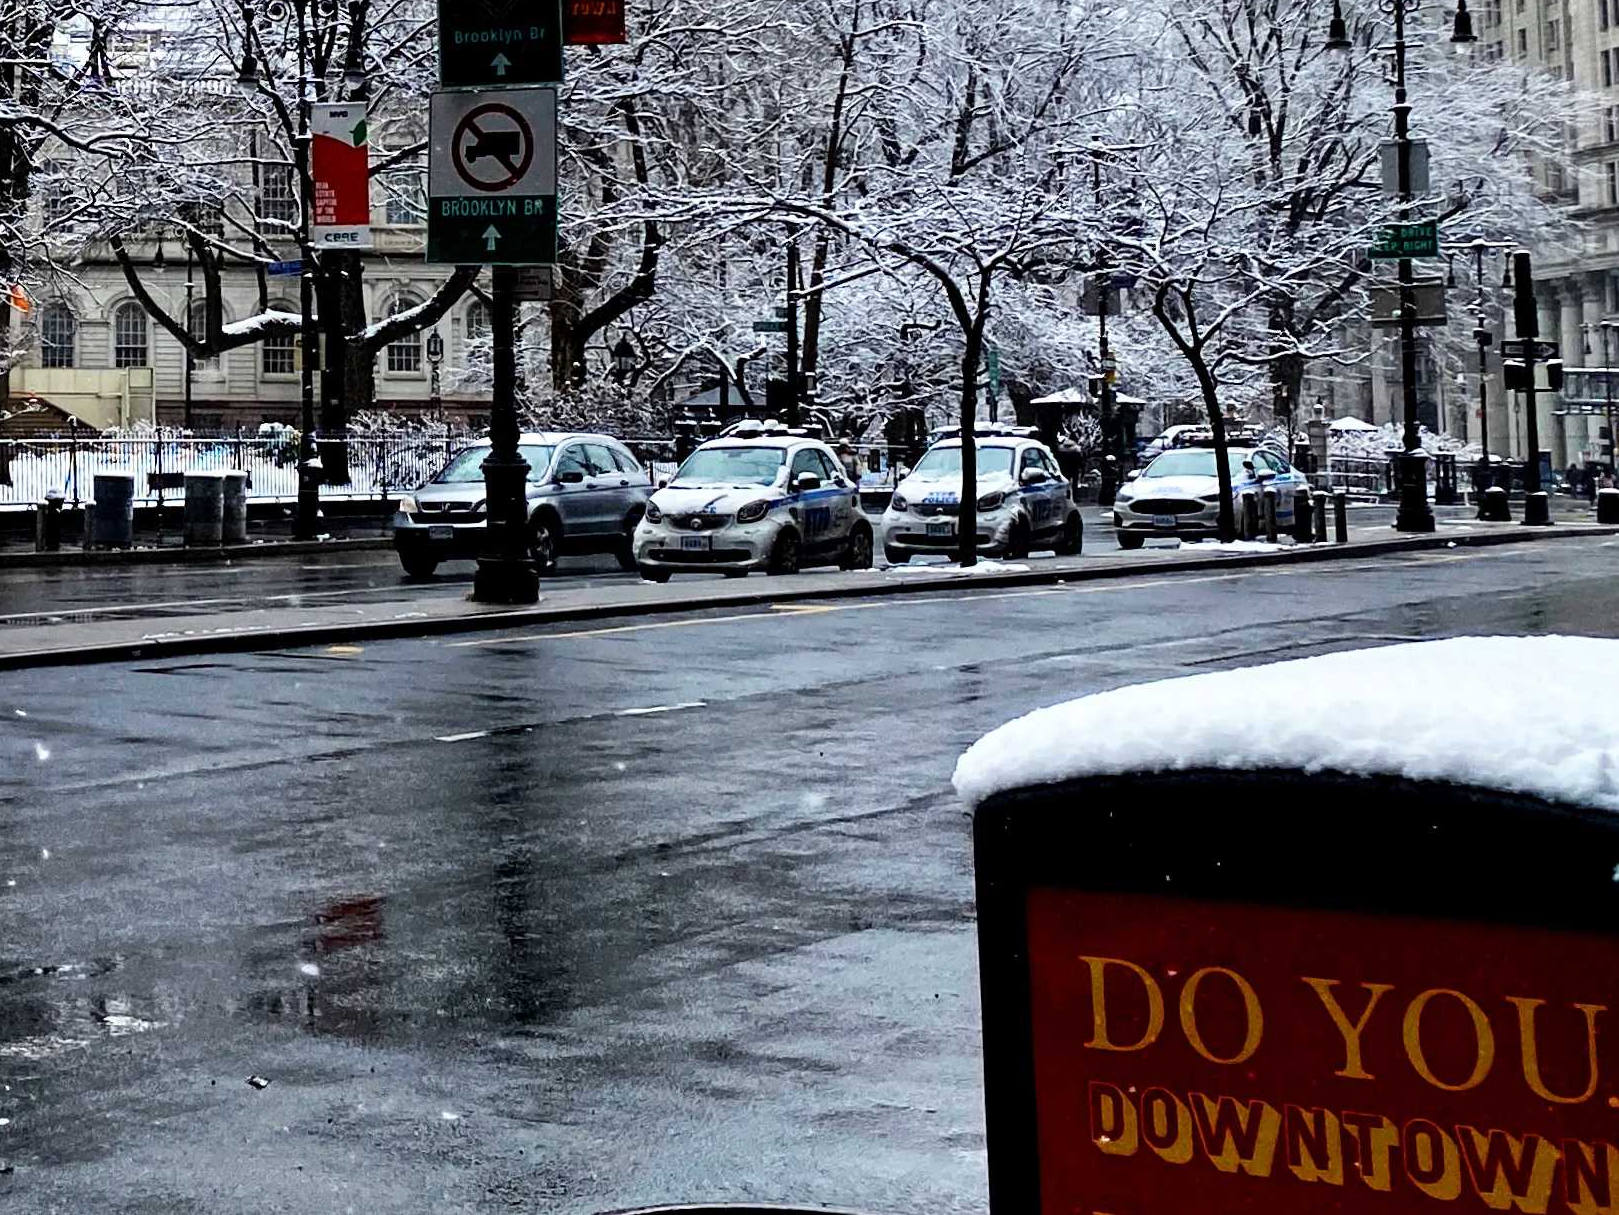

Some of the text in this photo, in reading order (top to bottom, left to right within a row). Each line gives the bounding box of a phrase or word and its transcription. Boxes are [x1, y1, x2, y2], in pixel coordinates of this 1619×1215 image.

[454, 26, 546, 44] Brooklyn Br
[442, 199, 544, 216] BROOKLYN BR
[1403, 240, 1433, 250] RIGHT
[1078, 955, 1265, 1066] DO
[1088, 1081, 1619, 1215] DOWNTOWN
